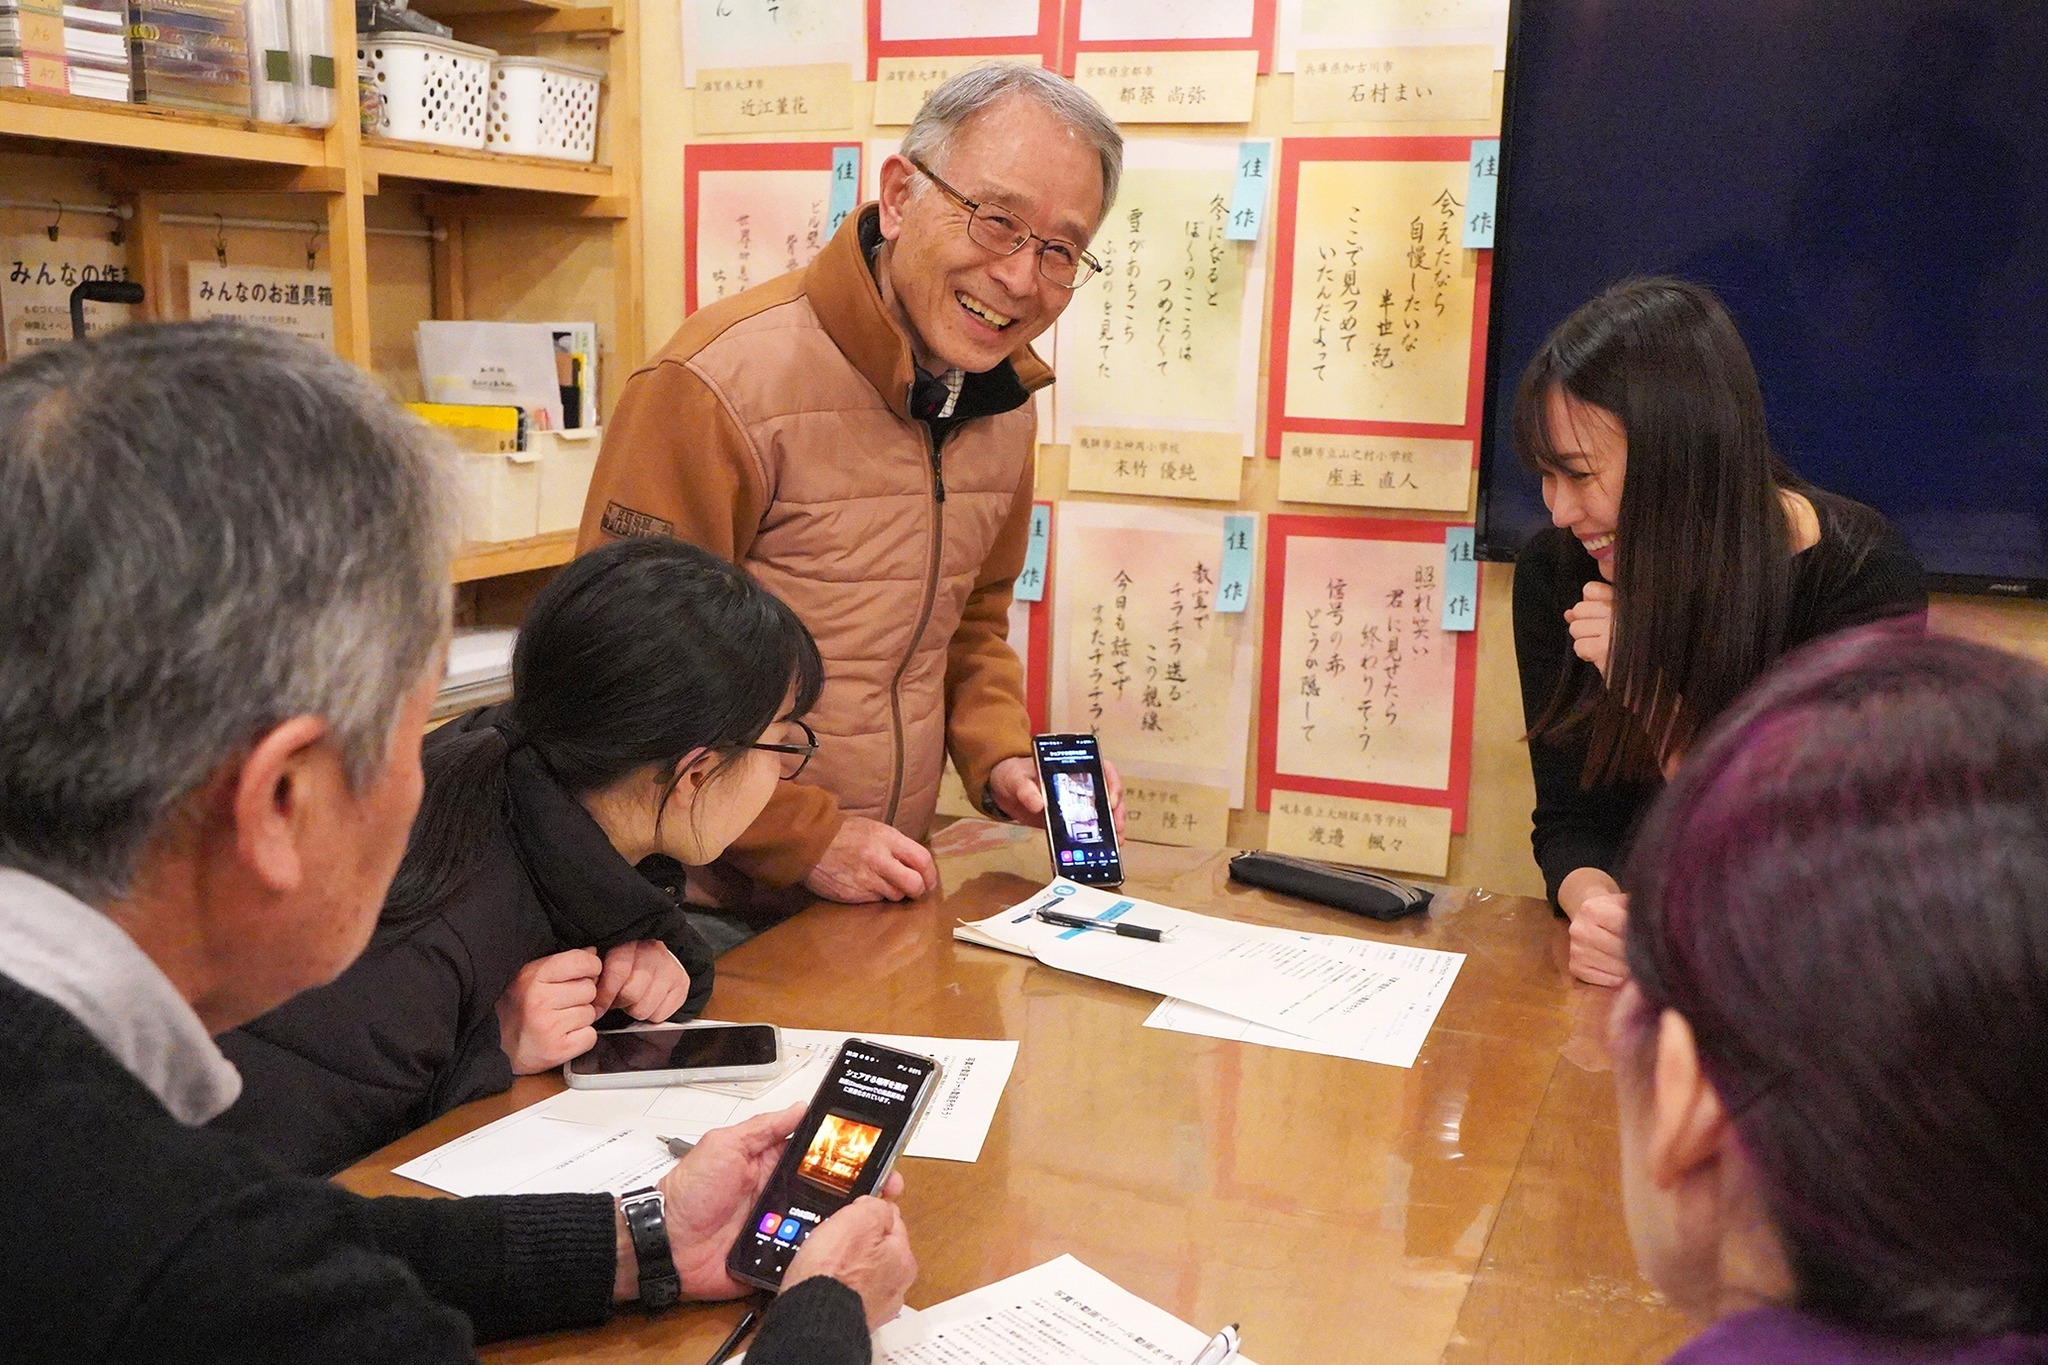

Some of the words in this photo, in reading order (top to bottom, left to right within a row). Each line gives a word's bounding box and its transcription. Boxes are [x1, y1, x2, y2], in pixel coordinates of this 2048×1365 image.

[766, 0, 780, 25] て
[1304, 60, 1395, 75] 兵庫県加古川市
[1348, 82, 1433, 104] 石村まい
[1233, 157, 1264, 228] 佳作
[1468, 157, 1499, 235] 佳作
[10, 261, 130, 286] みんなの作
[200, 281, 333, 306] みんなのお道具箱
[1124, 208, 1145, 344] 雪があちこち
[1179, 221, 1204, 361] ぼくのこころは
[1207, 194, 1230, 306] 冬になると
[1339, 206, 1363, 352] ここで見つめて
[1401, 216, 1431, 352] 自慢したいな
[1432, 188, 1466, 317] 会えたなら
[1098, 240, 1117, 378] ふるのを見てた
[1157, 279, 1174, 377] つめたくて
[1312, 246, 1337, 381] いたんだよって
[1371, 289, 1395, 370] 半世紀
[1326, 468, 1366, 487] 座主
[1378, 471, 1419, 489] 直人
[1192, 561, 1214, 629] 教室で
[1223, 531, 1249, 601] 佳作
[1412, 565, 1437, 655] 照れ笑い
[1447, 542, 1475, 617] 佳作
[1111, 570, 1133, 699] 今日も話せず
[1164, 582, 1187, 701] チラチラ送る
[1300, 608, 1321, 742] どうか隠して
[1326, 578, 1347, 678] 信号の赤
[1384, 589, 1405, 726] 君に見せたら
[1141, 645, 1163, 732] この視線
[1358, 625, 1382, 751] 終わりそう
